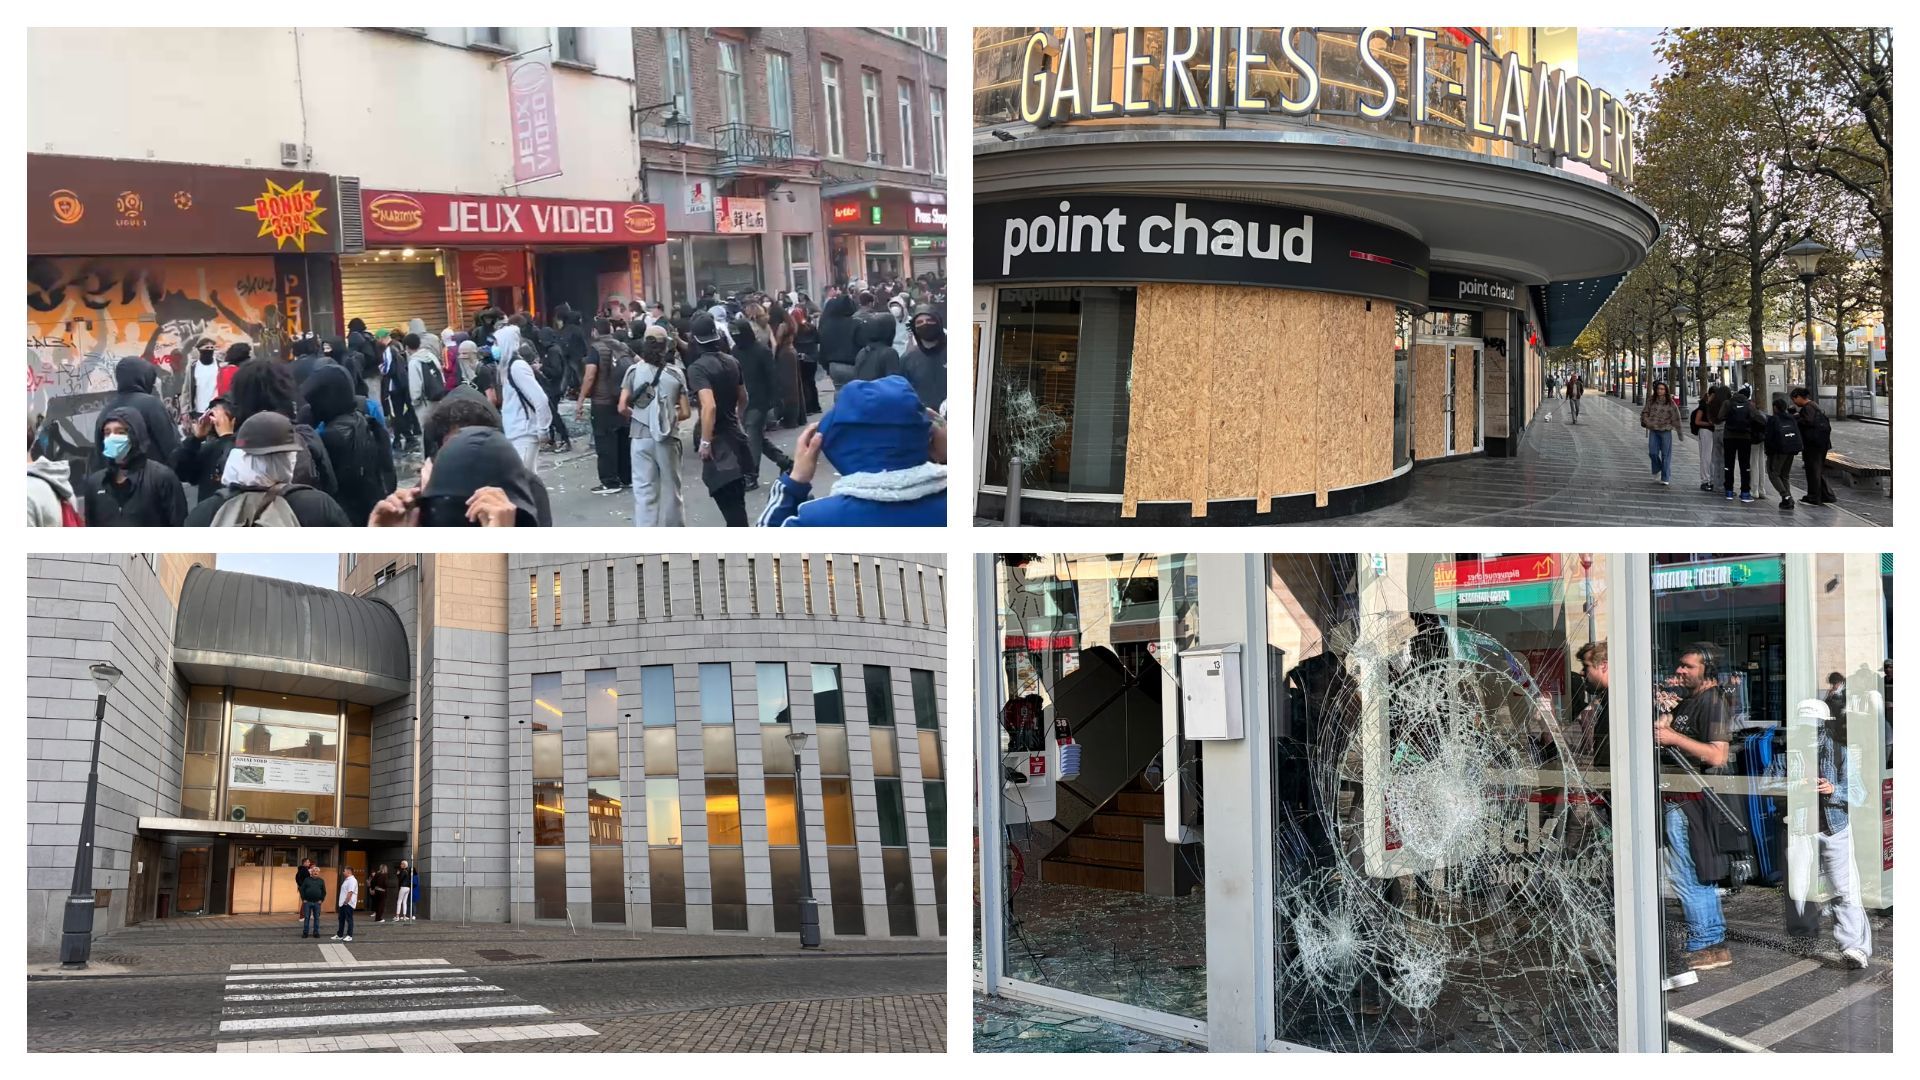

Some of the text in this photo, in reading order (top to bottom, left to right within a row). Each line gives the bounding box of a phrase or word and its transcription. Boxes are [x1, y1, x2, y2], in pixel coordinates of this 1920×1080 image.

[1021, 27, 1635, 183] GALERIES ST-LAMBERT
[516, 98, 535, 171] JEUX
[532, 92, 552, 170] VIDEO
[254, 191, 315, 220] BONUS
[438, 201, 523, 233] JEUX
[530, 204, 614, 234] VIDEO
[271, 214, 311, 238] 33%
[1002, 200, 1314, 276] point chaud
[1459, 279, 1515, 300] point chaud
[1213, 660, 1220, 669] 13
[1056, 719, 1067, 727] 38
[242, 823, 349, 838] PALAIS DE JUSTICE
